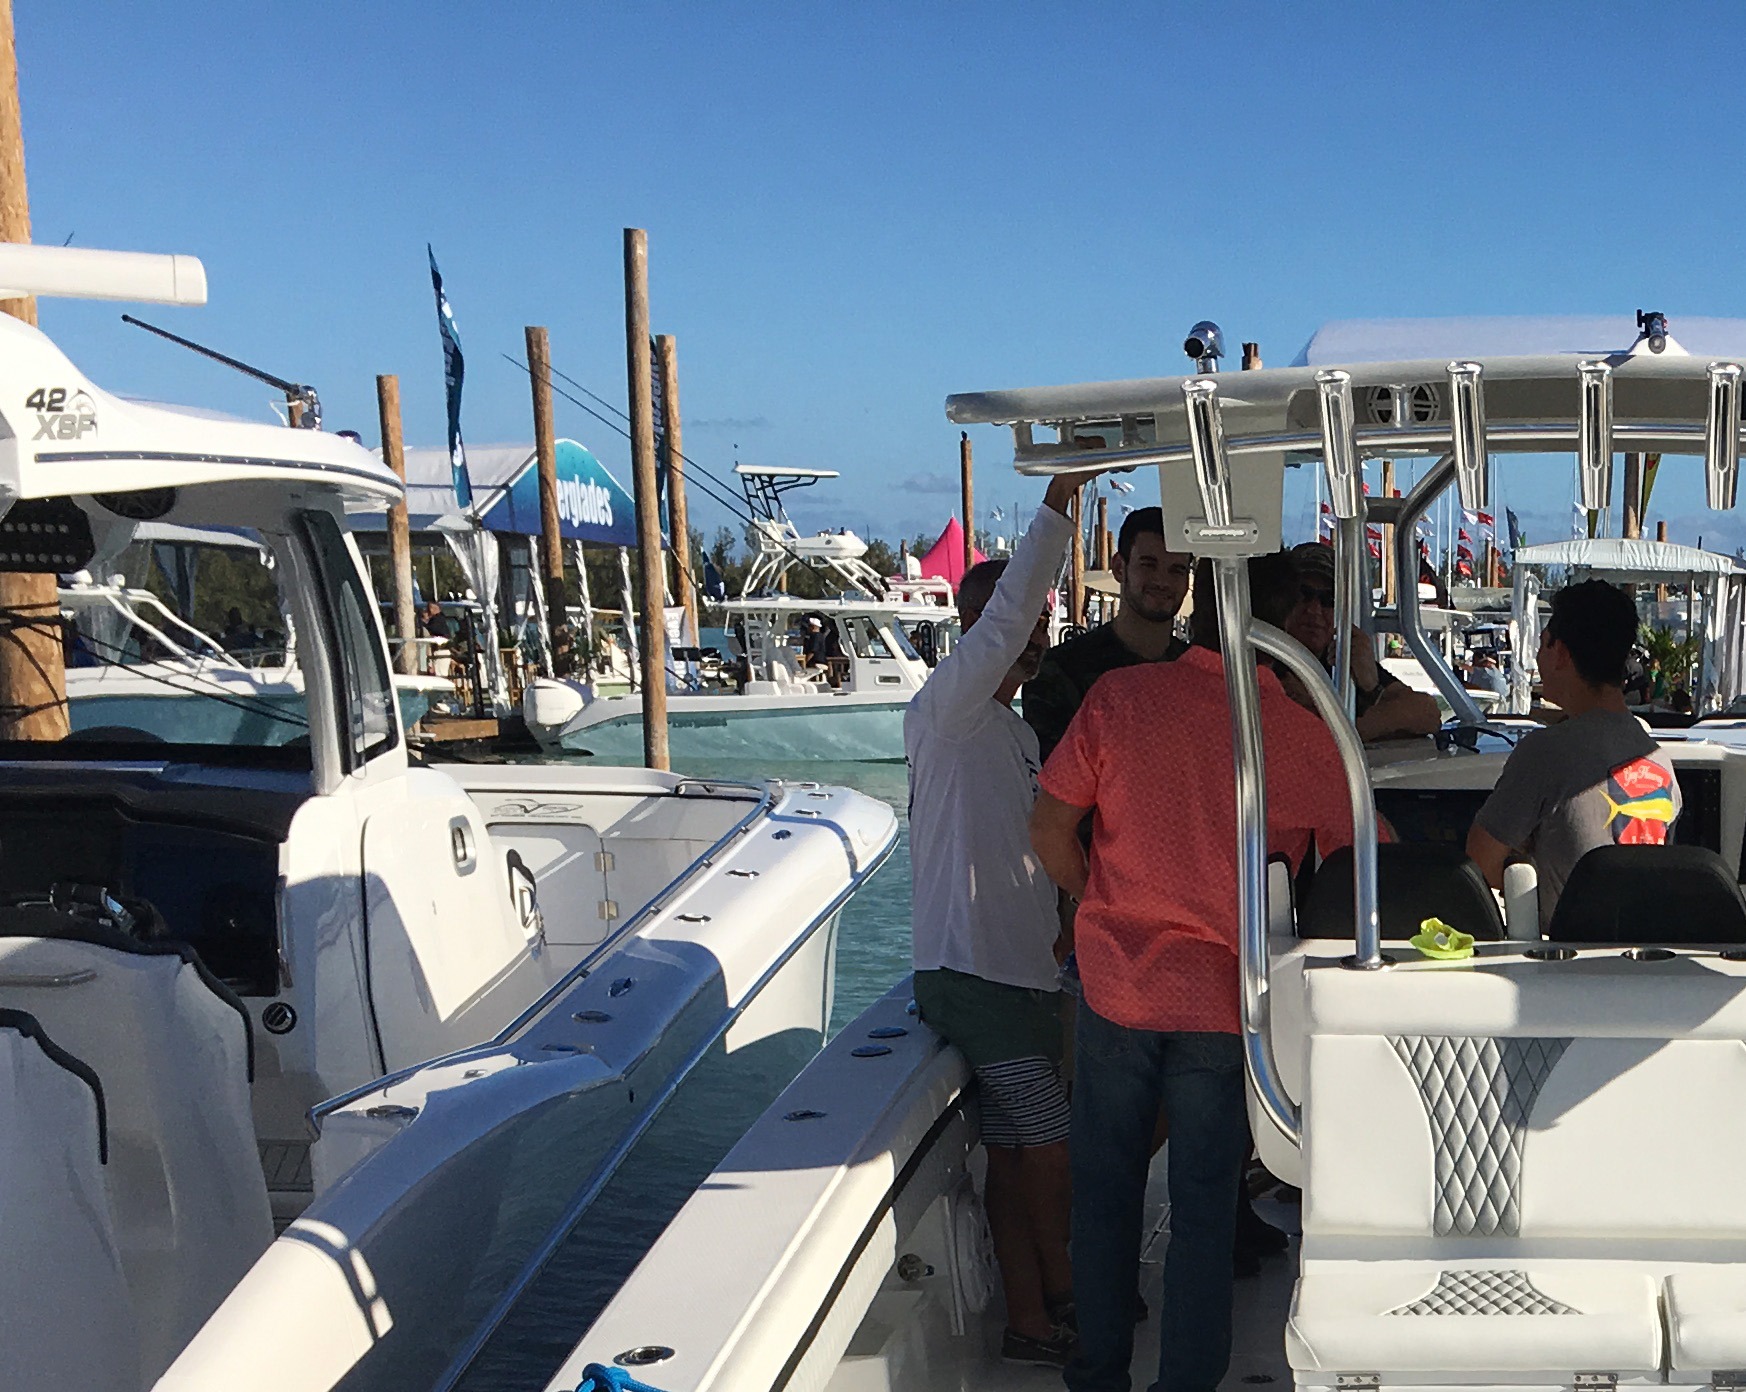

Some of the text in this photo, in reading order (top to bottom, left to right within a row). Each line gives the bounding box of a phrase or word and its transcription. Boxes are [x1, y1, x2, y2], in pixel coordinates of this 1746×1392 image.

[25, 387, 67, 412] 42
[31, 413, 97, 441] XSF
[557, 475, 613, 528] erglades
